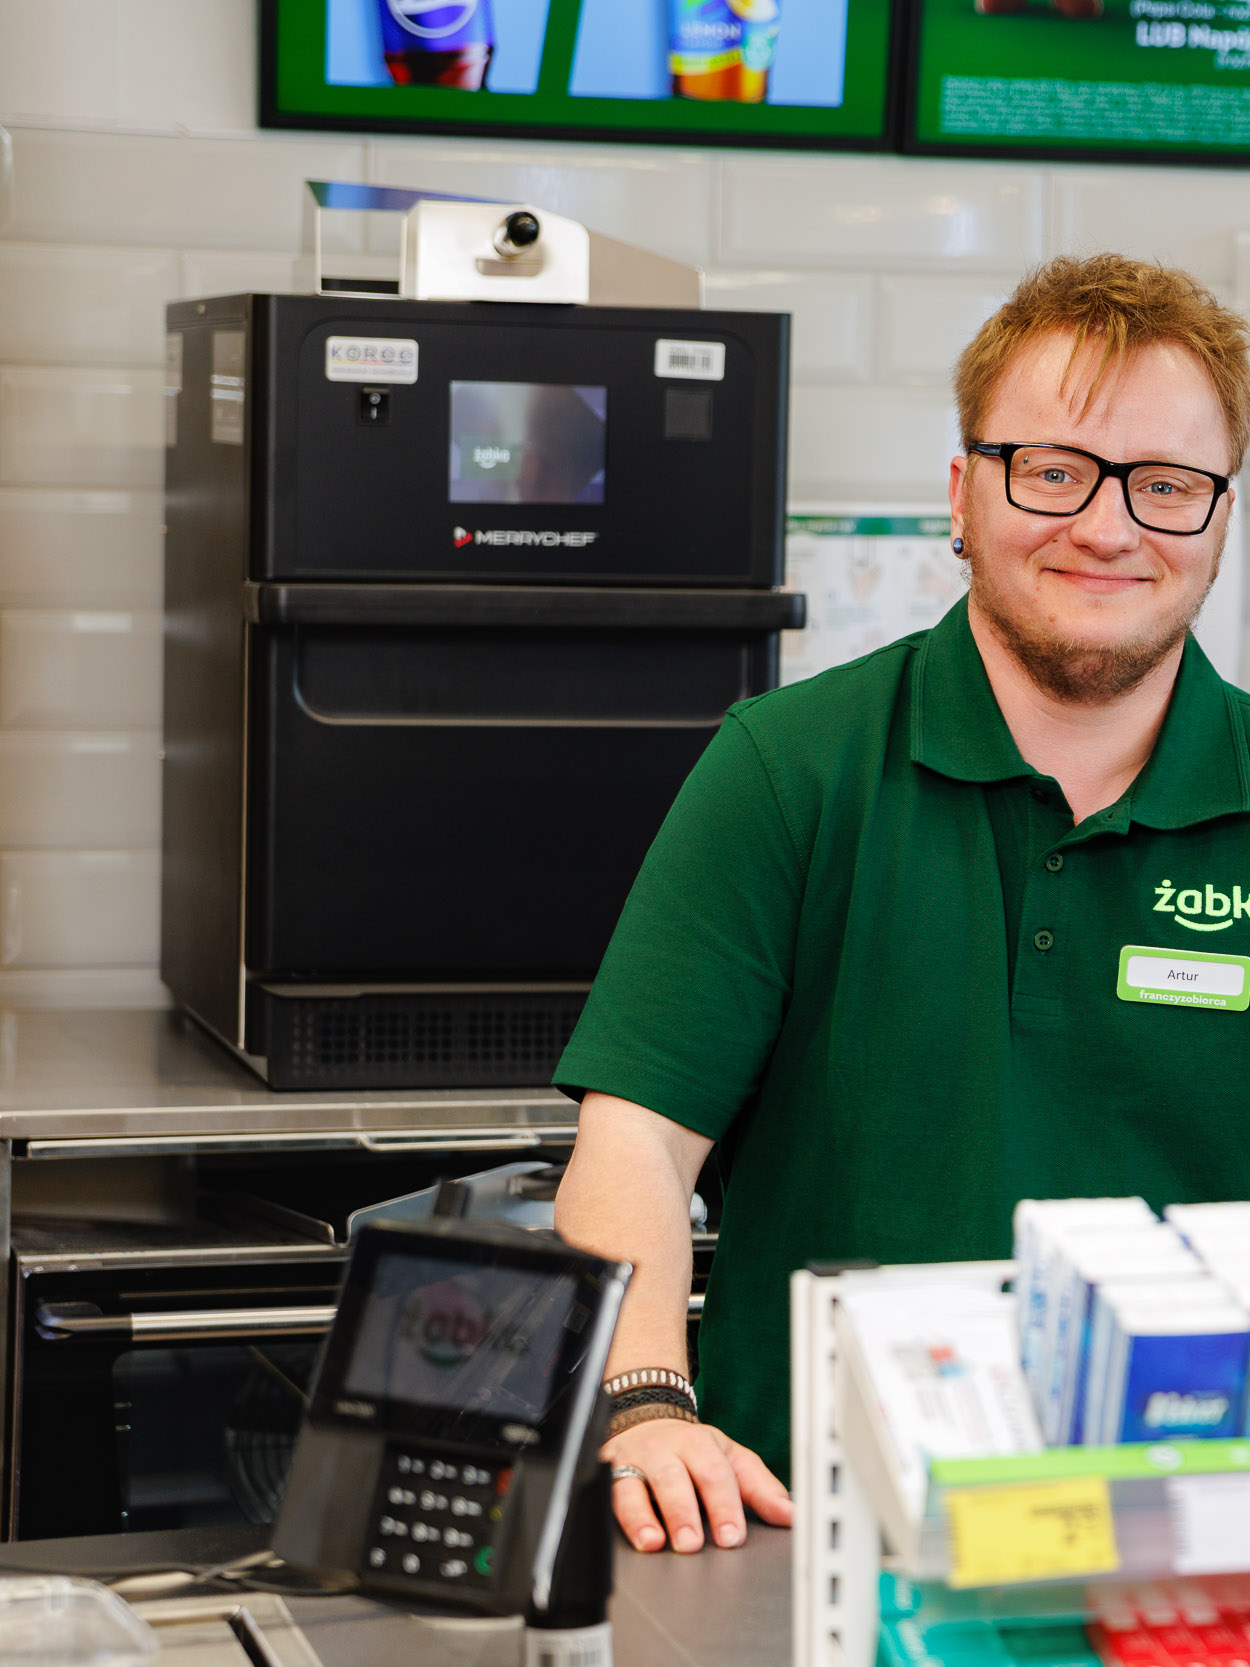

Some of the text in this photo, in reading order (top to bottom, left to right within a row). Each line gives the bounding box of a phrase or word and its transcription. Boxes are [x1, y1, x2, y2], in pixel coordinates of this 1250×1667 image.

[1136, 20, 1187, 48] LUB
[474, 530, 598, 547] MERRYCHEF
[1167, 969, 1200, 982] Artur
[1139, 989, 1227, 1007] franczyzobiorca
